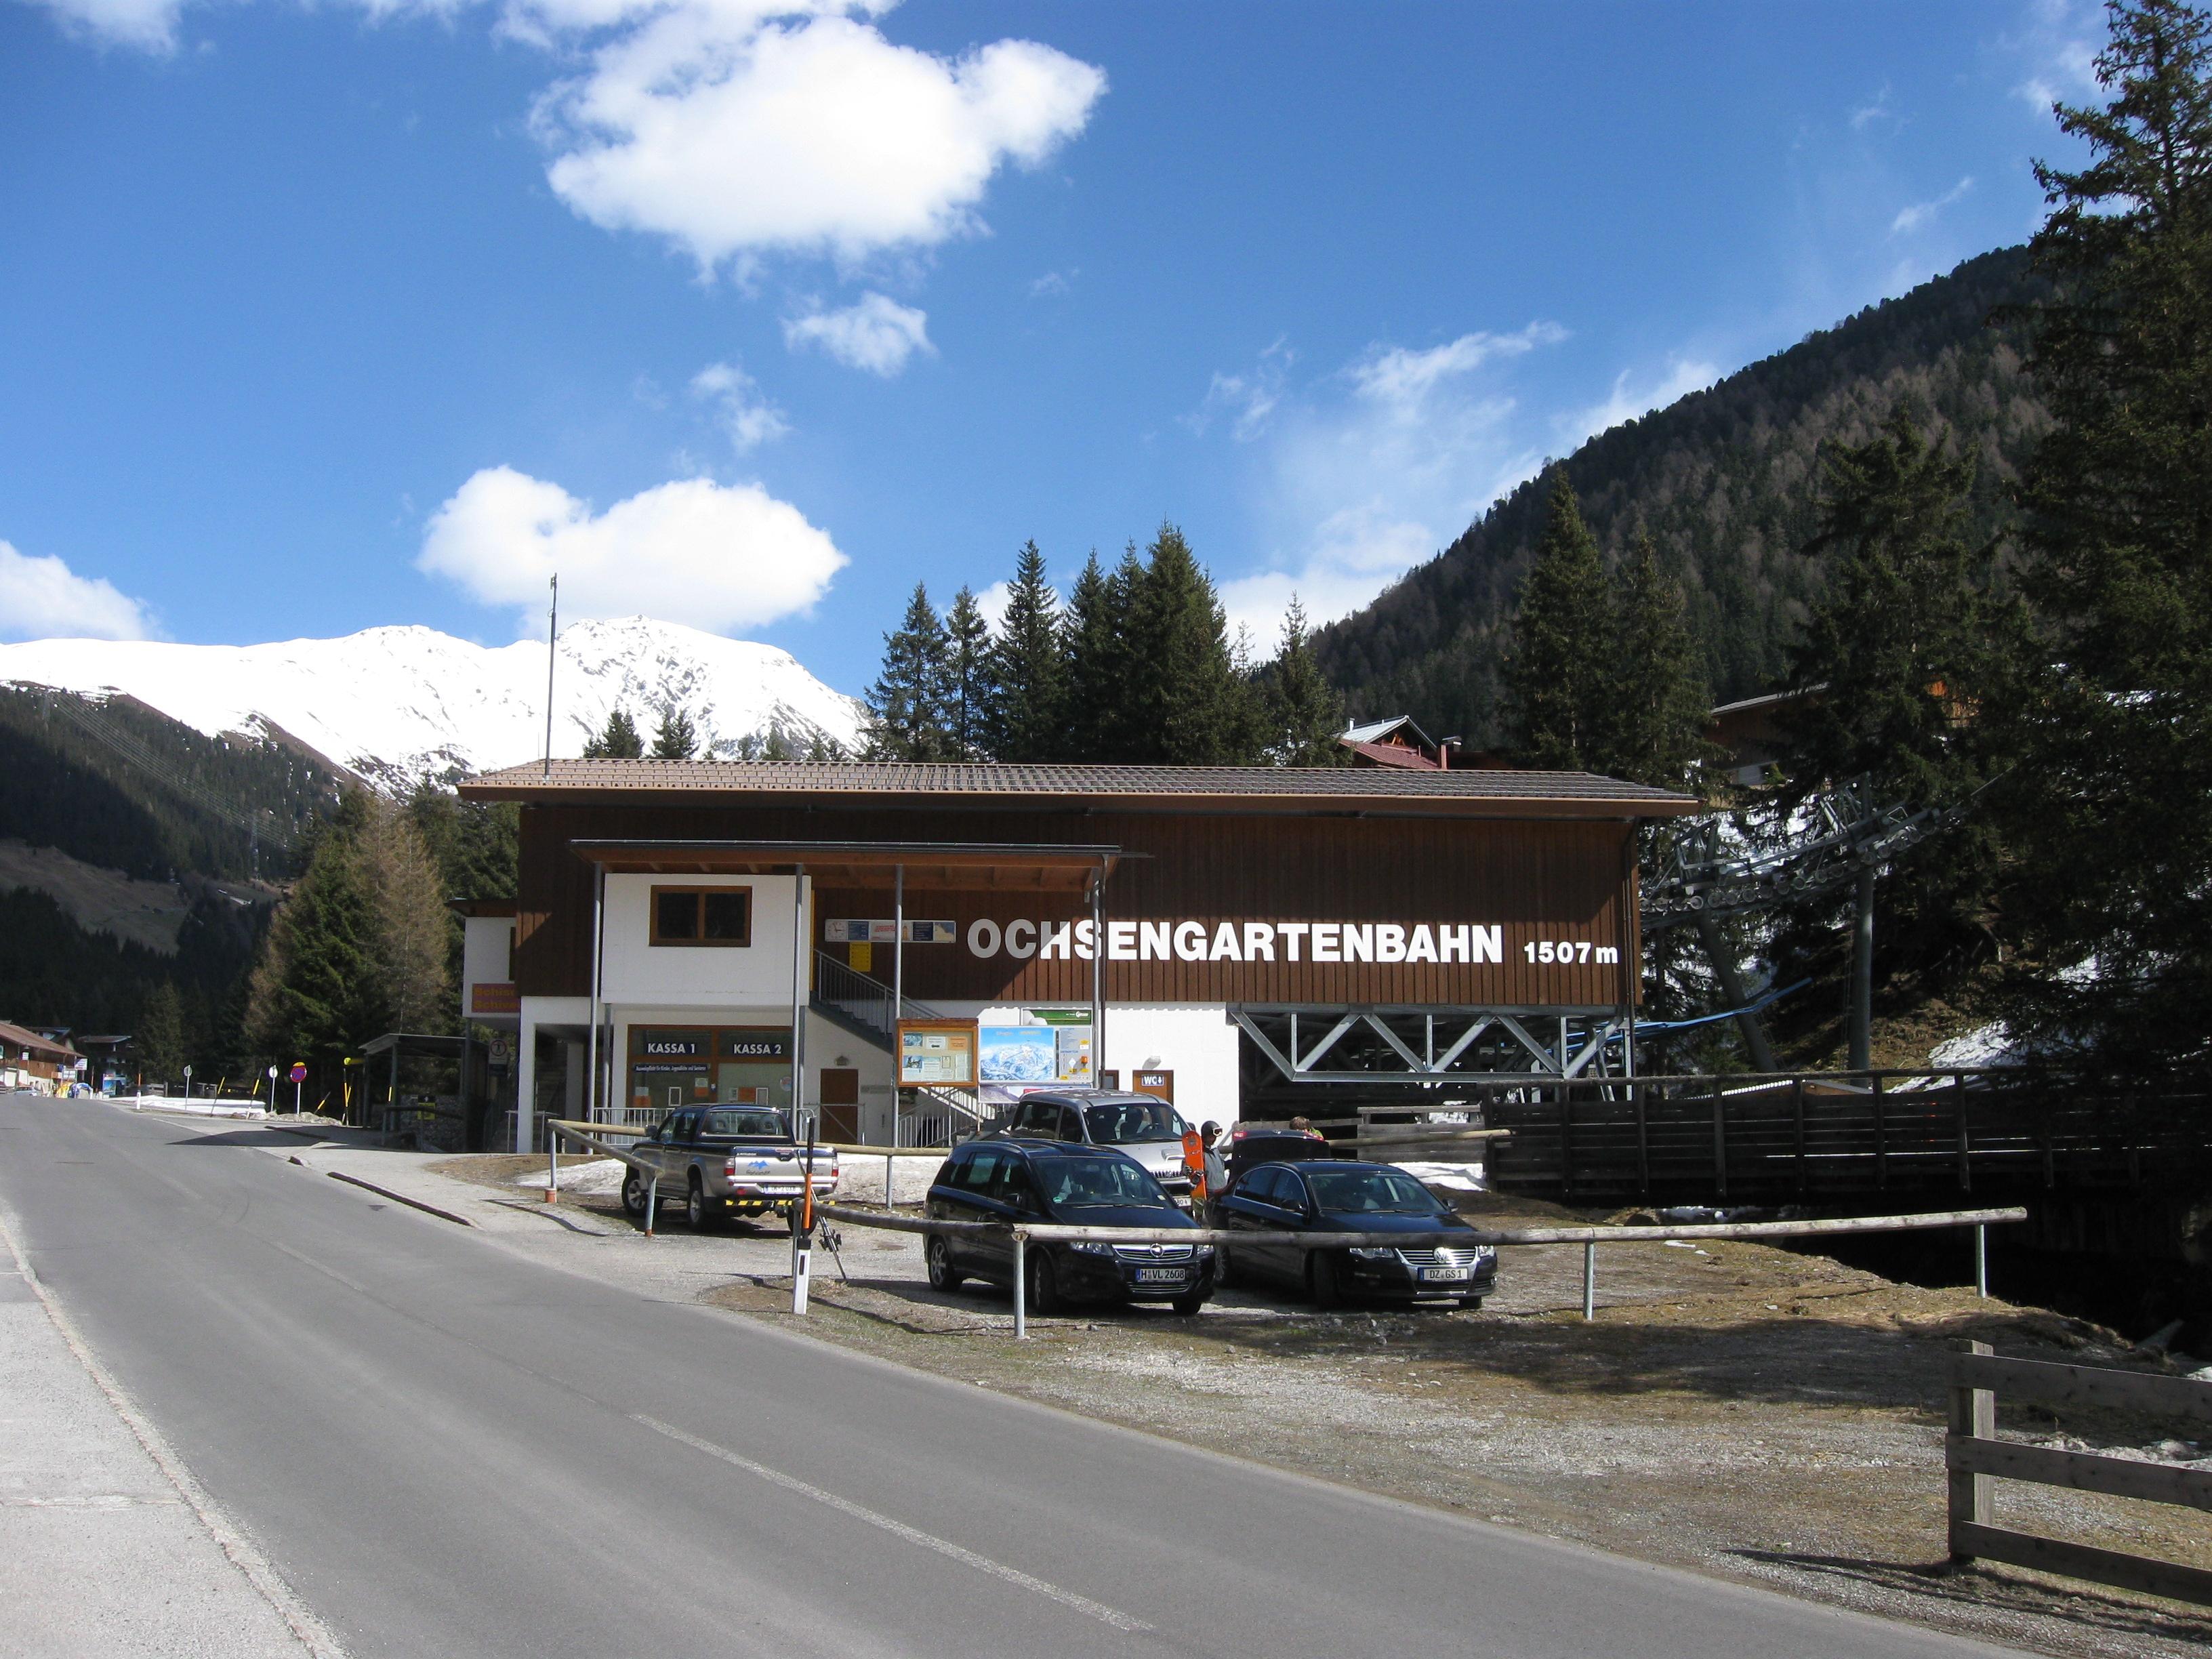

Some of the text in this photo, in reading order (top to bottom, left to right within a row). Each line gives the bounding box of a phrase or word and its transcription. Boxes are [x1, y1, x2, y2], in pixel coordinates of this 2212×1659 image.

[967, 918, 1502, 964] OCHSENGARTENBAHN
[647, 1043, 695, 1053] KASSA 1
[733, 1044, 781, 1054] KASSA 2
[1143, 1076, 1157, 1085] WC
[1429, 1270, 1440, 1279] DZ
